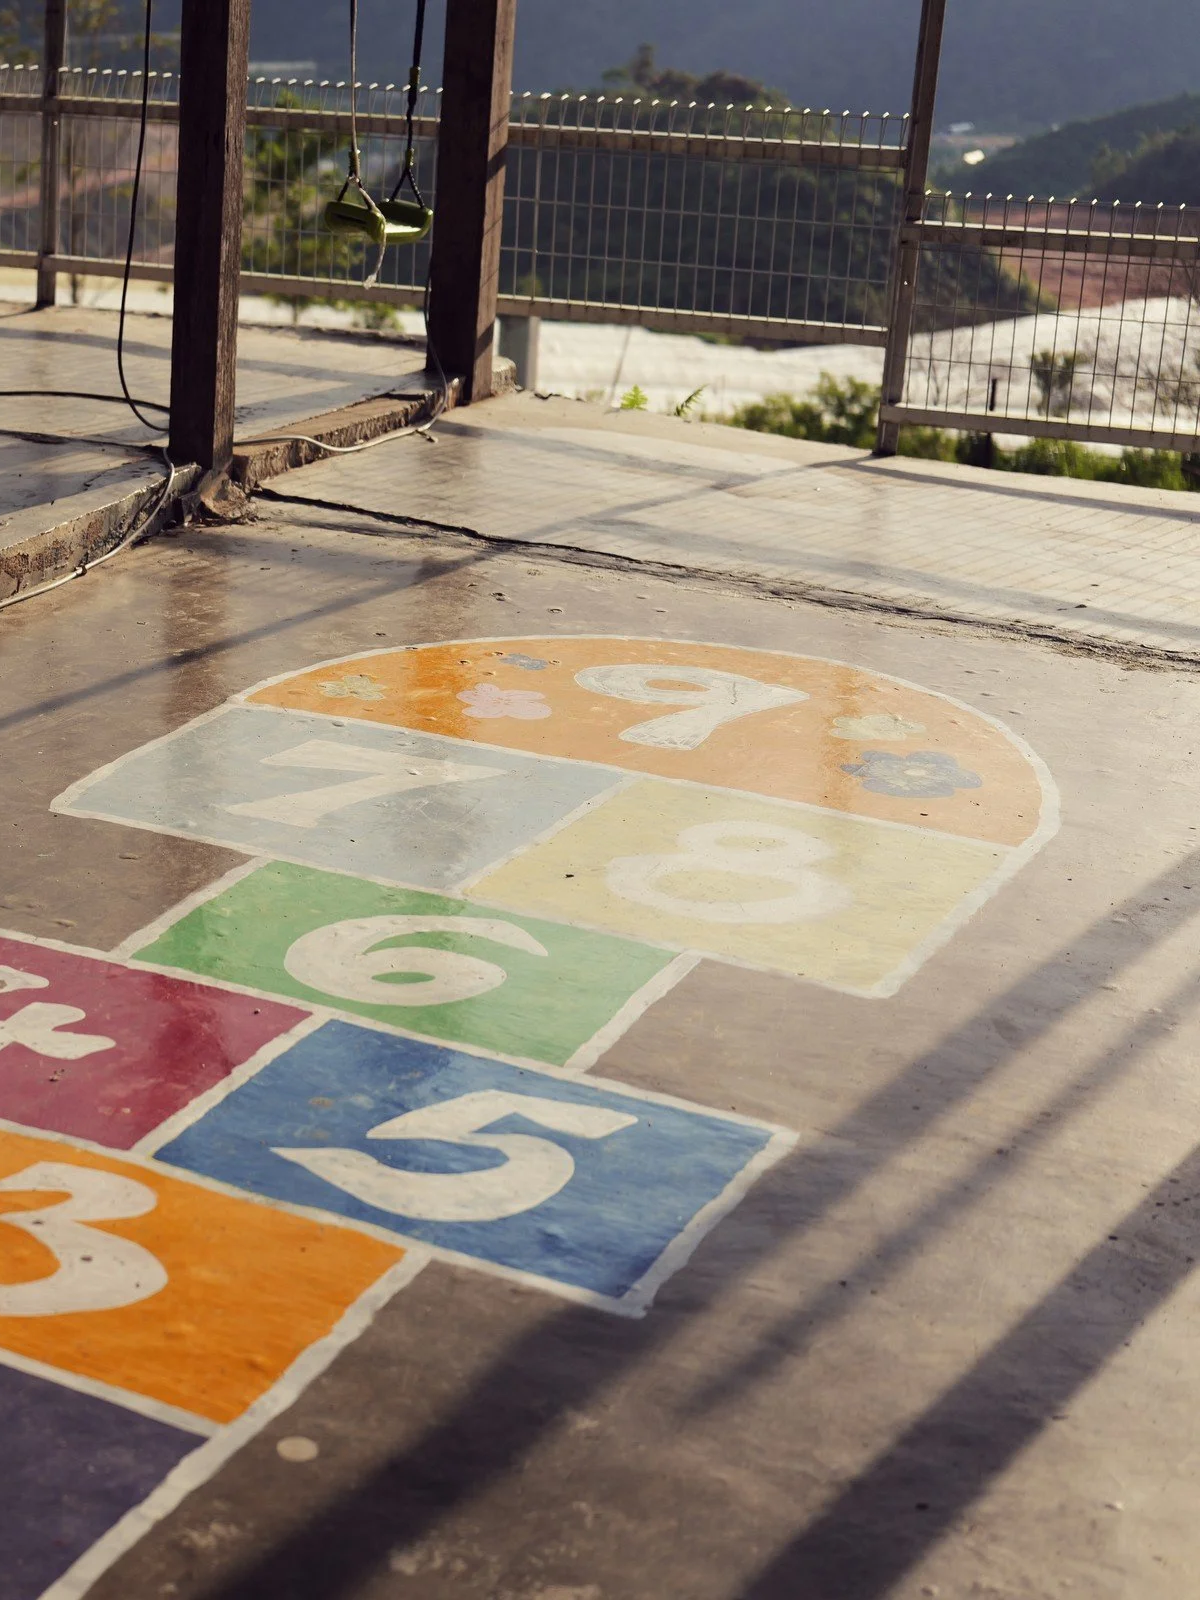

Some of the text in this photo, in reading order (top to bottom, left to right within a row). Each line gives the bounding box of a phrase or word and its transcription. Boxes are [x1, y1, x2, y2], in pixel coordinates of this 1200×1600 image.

[574, 664, 810, 750] 9
[222, 739, 508, 828] 7
[606, 820, 850, 924] 8
[284, 915, 548, 1005] 6
[271, 1089, 637, 1223] 5
